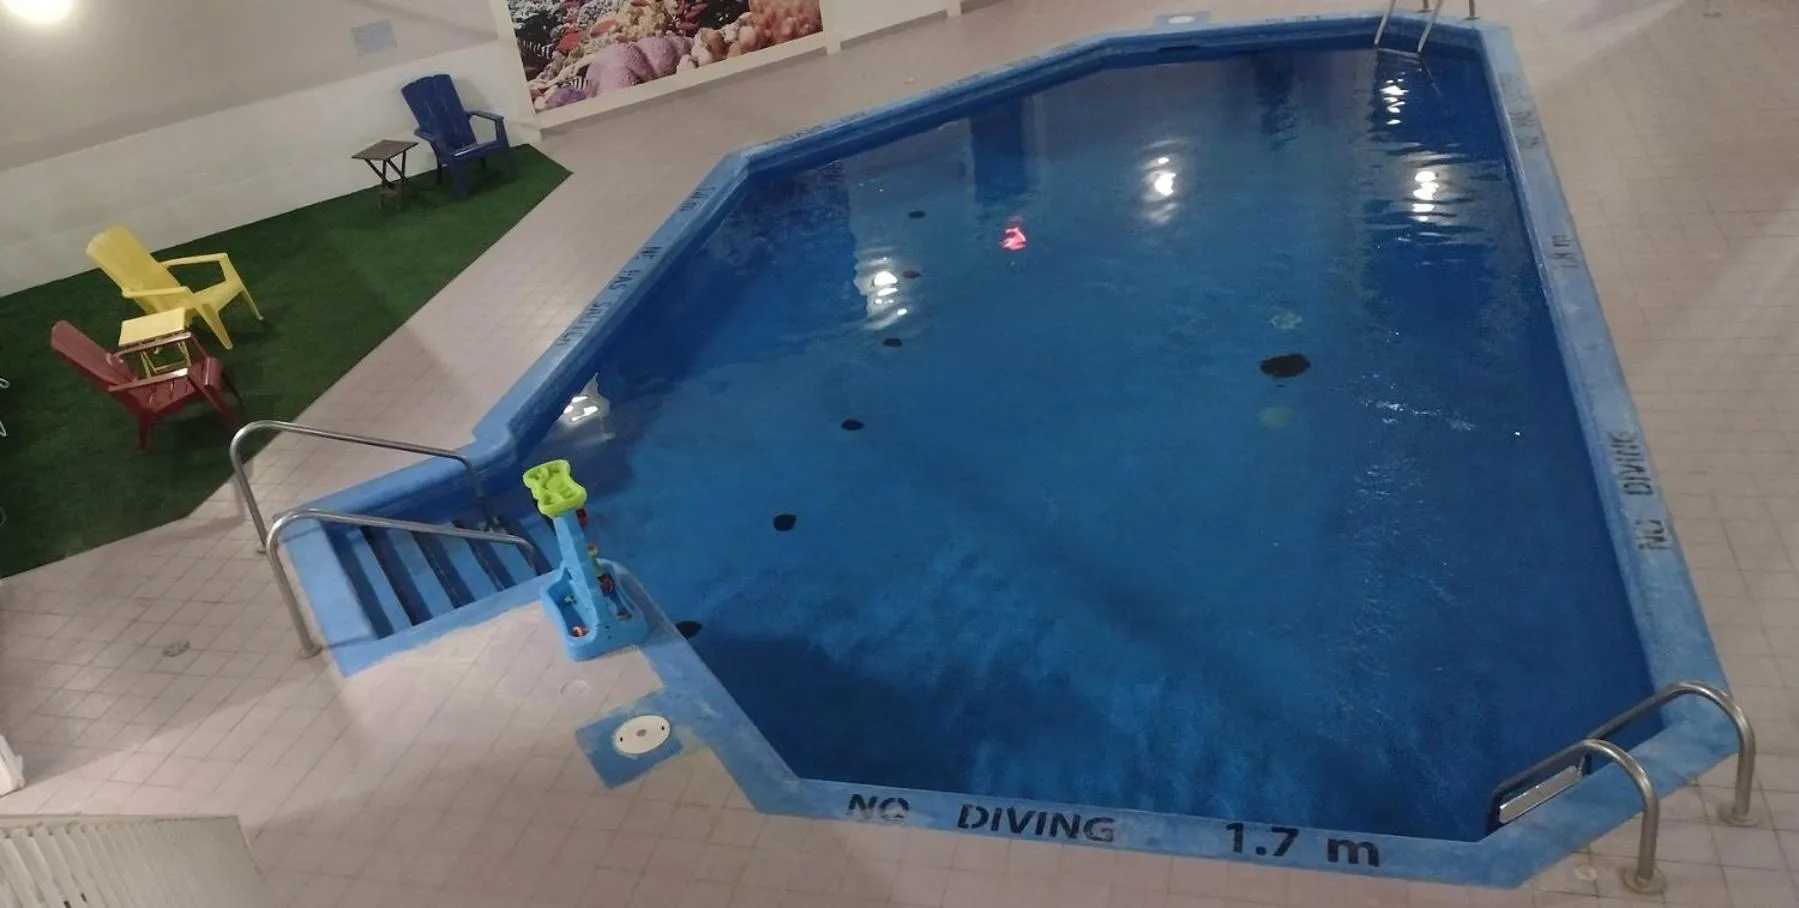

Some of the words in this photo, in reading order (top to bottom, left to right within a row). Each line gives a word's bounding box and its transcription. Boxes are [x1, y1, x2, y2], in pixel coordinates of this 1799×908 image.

[1607, 430, 1653, 495] DIVING
[1635, 519, 1672, 550] NO
[848, 794, 910, 820] NO
[957, 803, 1117, 843] DIVING
[1225, 822, 1300, 857] 1.7
[1327, 838, 1380, 868] m
